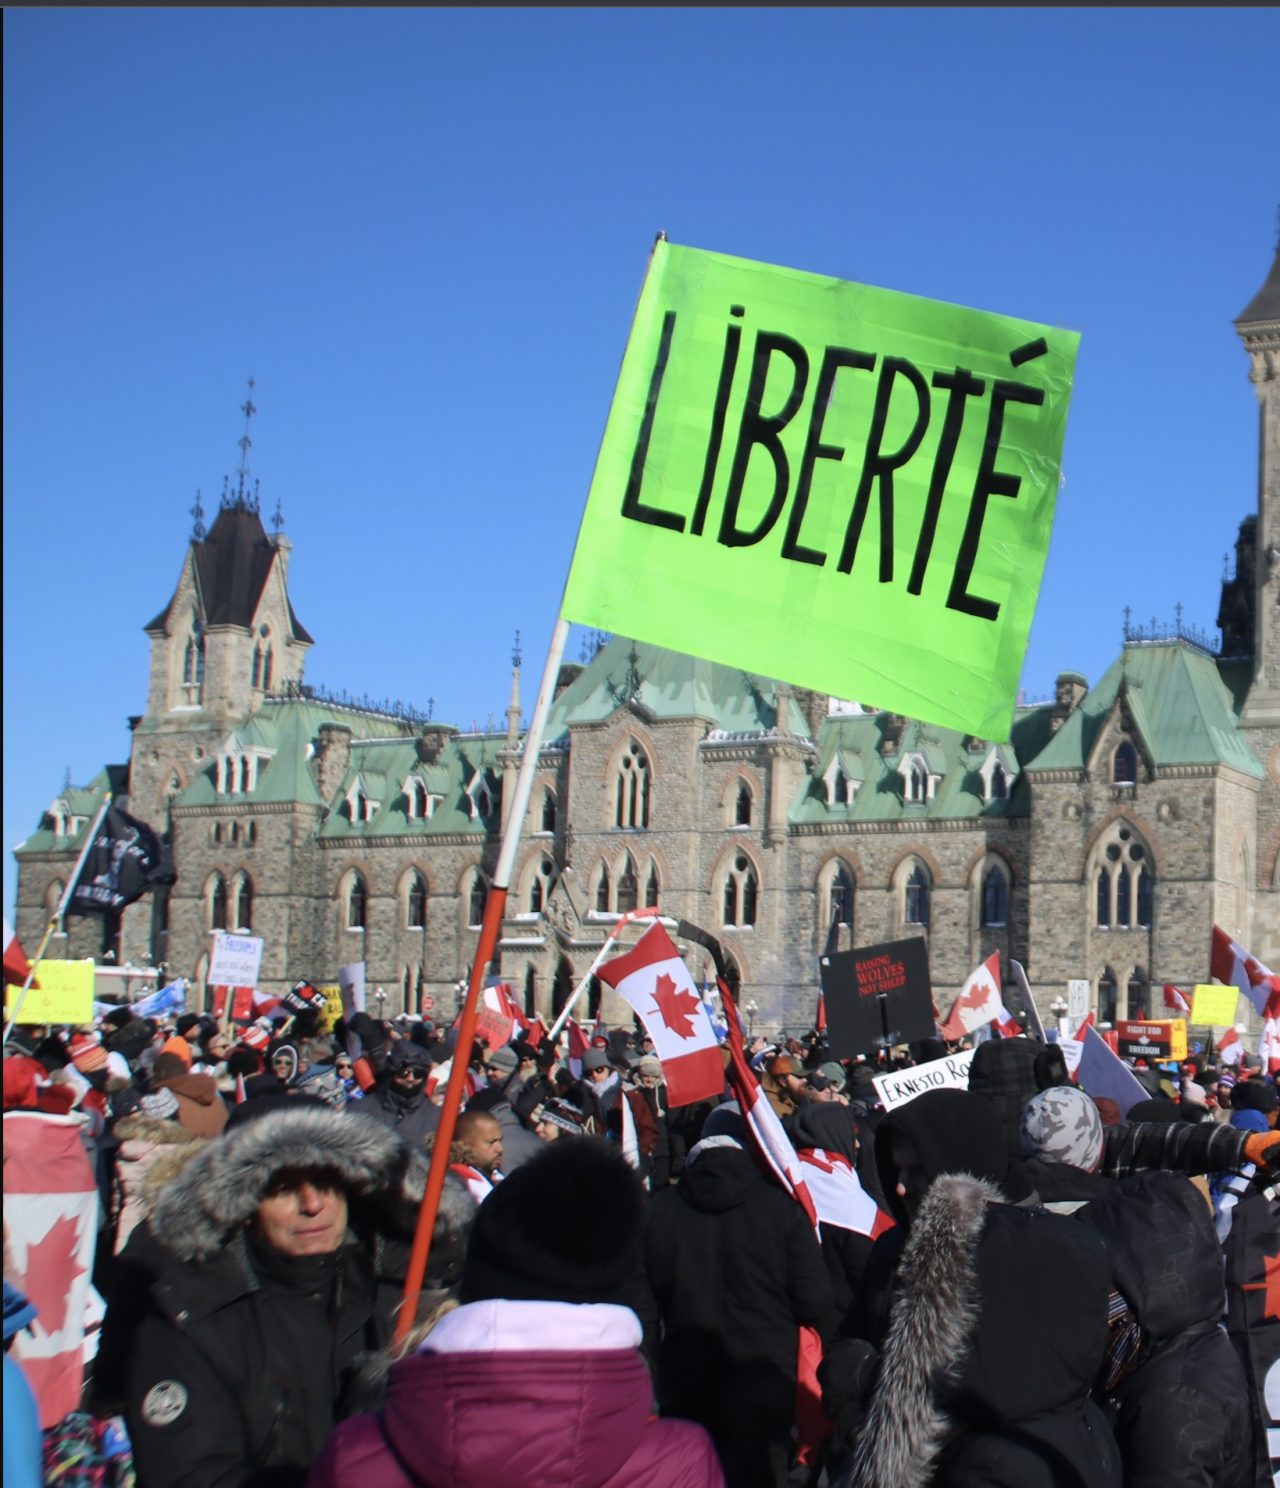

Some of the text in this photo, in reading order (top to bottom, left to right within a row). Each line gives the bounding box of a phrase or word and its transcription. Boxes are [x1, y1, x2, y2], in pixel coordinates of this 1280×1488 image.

[855, 956, 890, 972] RAISING
[857, 962, 905, 984] WOLVES
[858, 975, 906, 997] NOT SHEEP
[1127, 1026, 1162, 1035] FIGHT FOR
[1129, 1045, 1161, 1055] FREEDOM
[882, 1071, 945, 1103] ERNESTO
